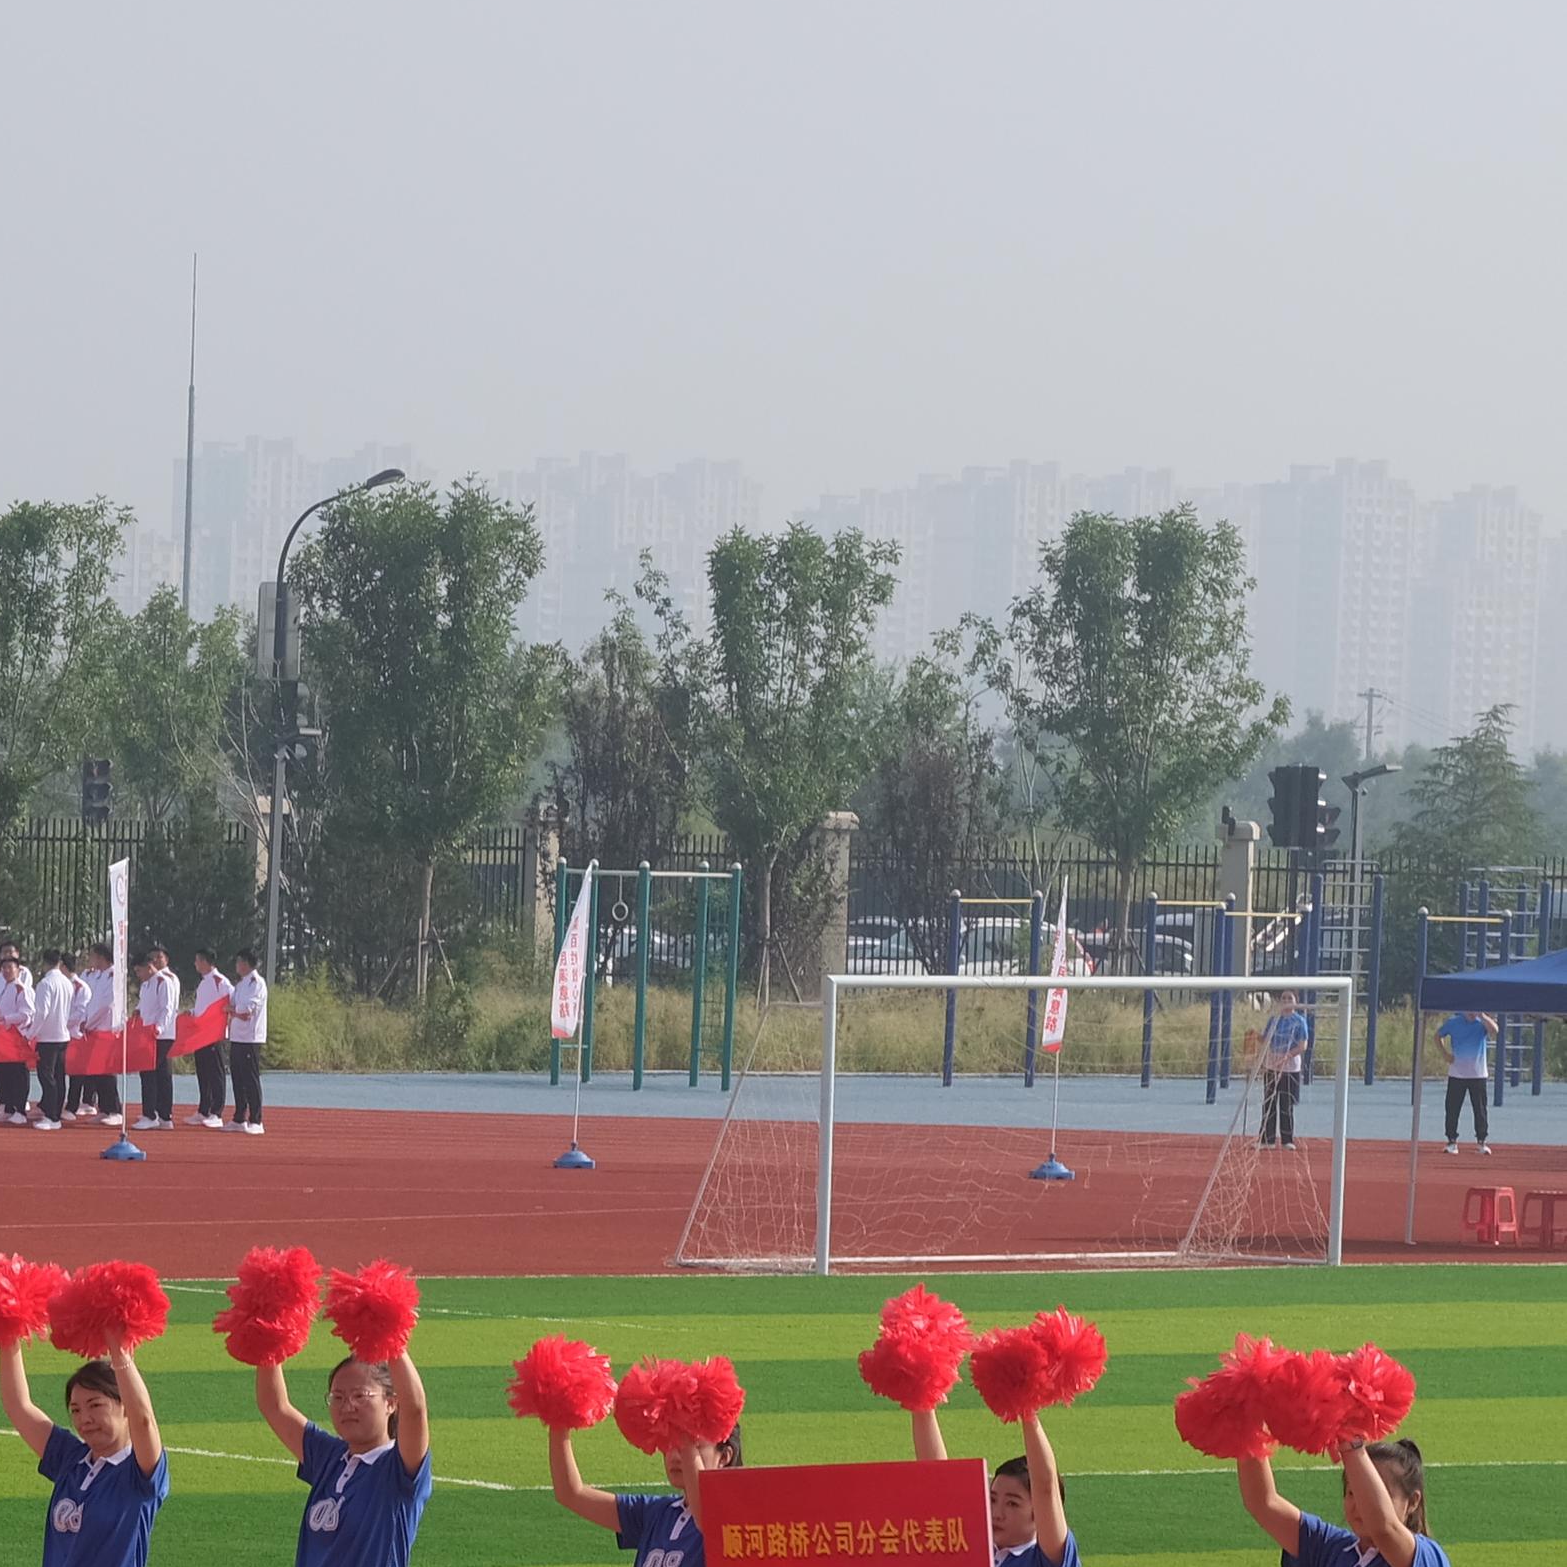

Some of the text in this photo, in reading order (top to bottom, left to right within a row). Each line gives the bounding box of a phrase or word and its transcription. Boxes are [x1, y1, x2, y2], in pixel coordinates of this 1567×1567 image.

[723, 1517, 969, 1559] 顺河路桥公司分会代表队
